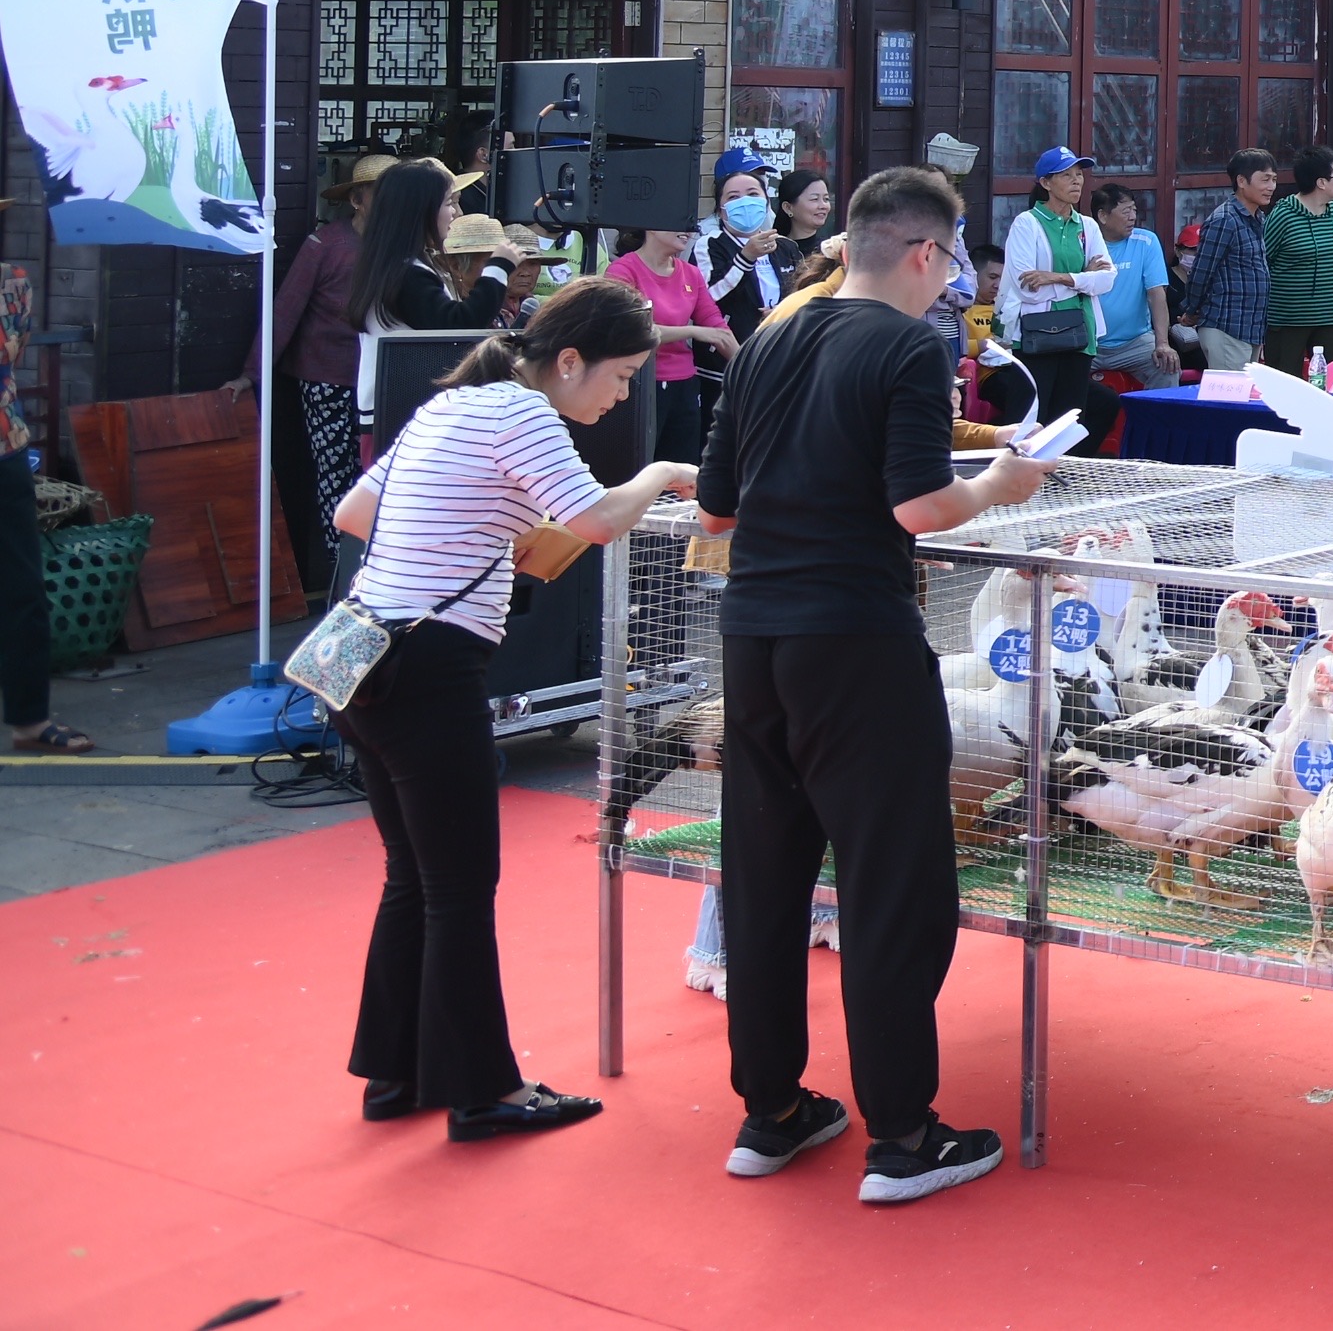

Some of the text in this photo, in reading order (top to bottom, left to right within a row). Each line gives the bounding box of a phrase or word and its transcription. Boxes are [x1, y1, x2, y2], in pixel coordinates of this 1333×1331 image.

[885, 51, 910, 60] 12345
[884, 70, 910, 79] 12315
[884, 87, 909, 96] 12301
[1062, 606, 1089, 626] 13
[1053, 624, 1088, 647] 公鸭
[1005, 635, 1031, 654] 14
